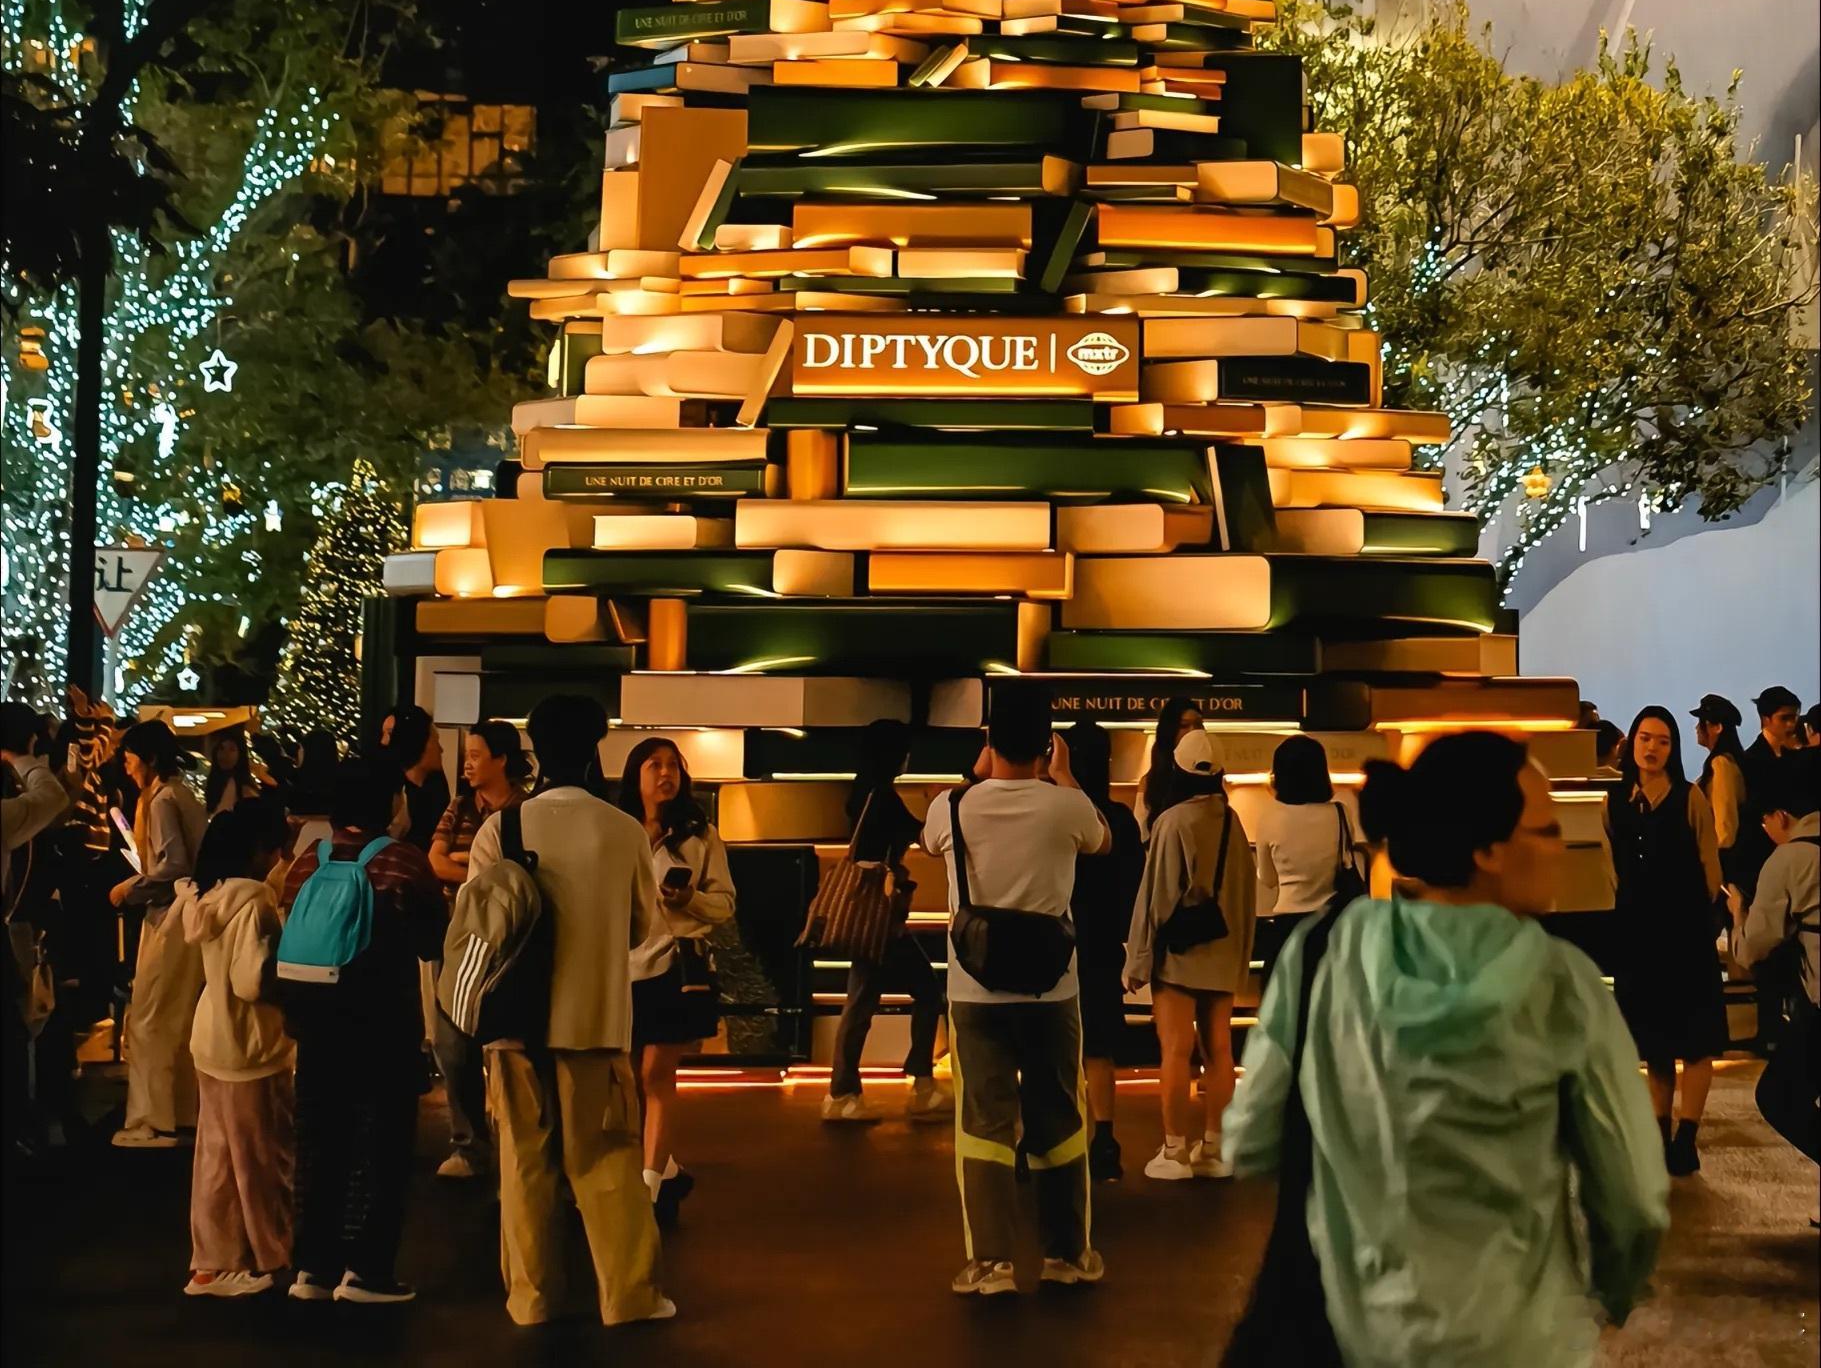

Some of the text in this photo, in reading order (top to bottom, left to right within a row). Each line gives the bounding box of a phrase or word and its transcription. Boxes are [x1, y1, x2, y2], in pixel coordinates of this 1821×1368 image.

[634, 17, 652, 29] UNE
[655, 15, 676, 27] NUIT
[802, 333, 1039, 378] DIPTYQUE
[585, 476, 724, 487] UNE NUIT DE CIRE ET D'OR
[94, 556, 134, 593] 让
[1050, 696, 1081, 711] UNE
[1085, 696, 1122, 711] NUIT
[1127, 696, 1145, 711] DE
[1209, 696, 1244, 711] D'OR
